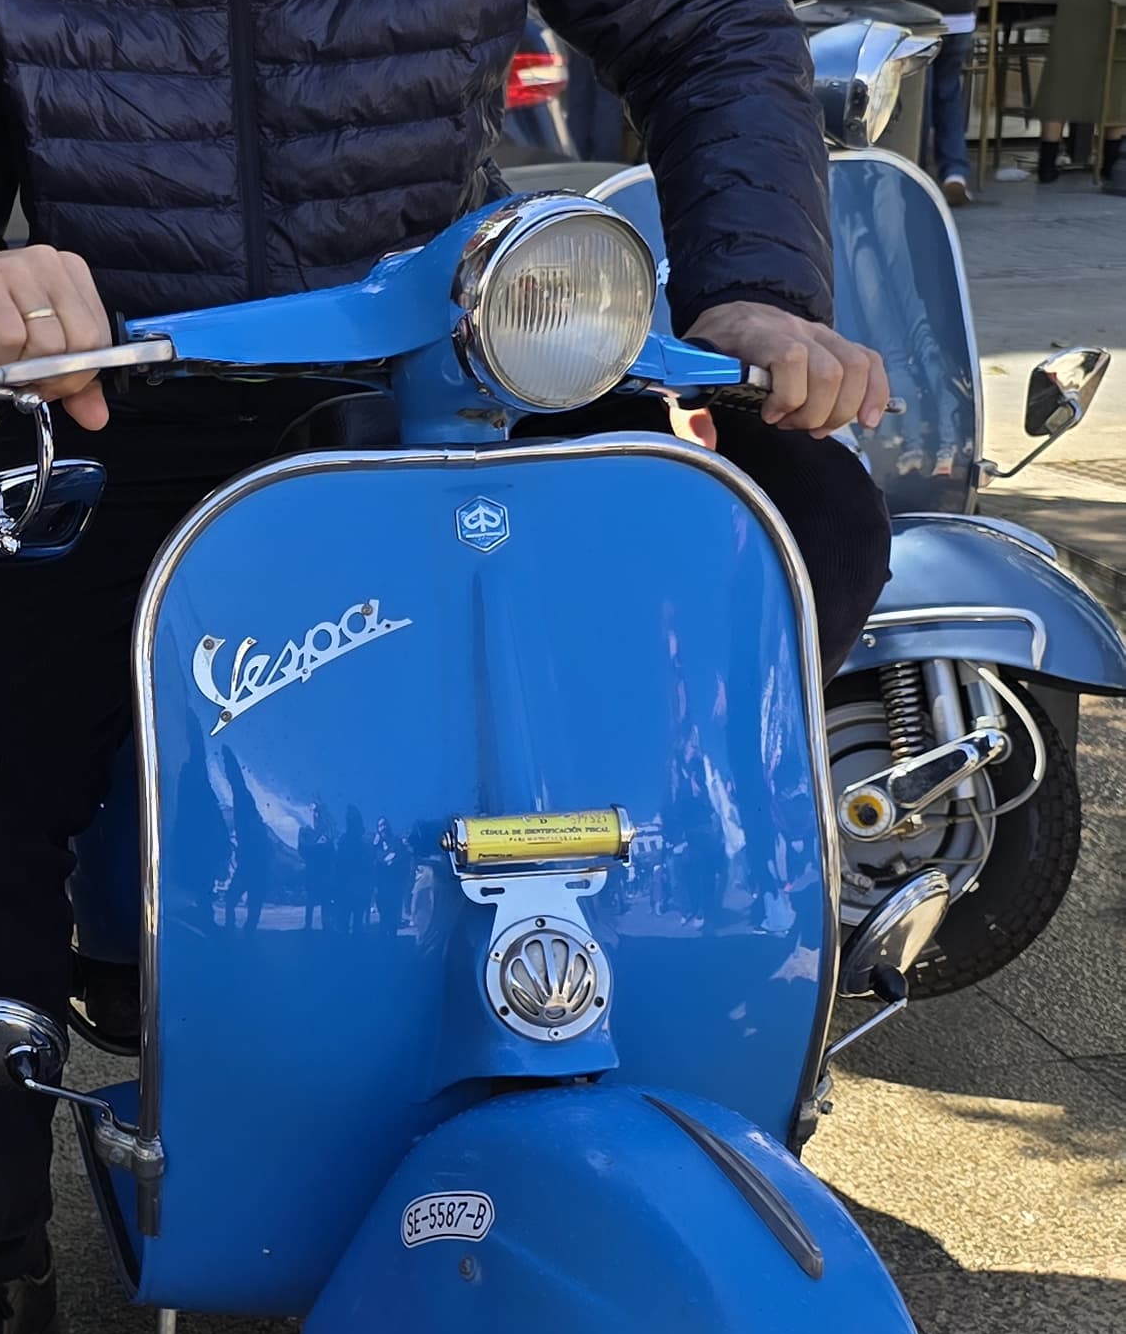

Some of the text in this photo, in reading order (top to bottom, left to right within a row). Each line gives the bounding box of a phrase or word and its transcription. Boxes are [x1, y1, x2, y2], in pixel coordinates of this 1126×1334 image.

[193, 599, 414, 737] Vespa
[524, 826, 582, 835] IDENTIFICACIÓN
[406, 1201, 487, 1237] SE-5587-B
